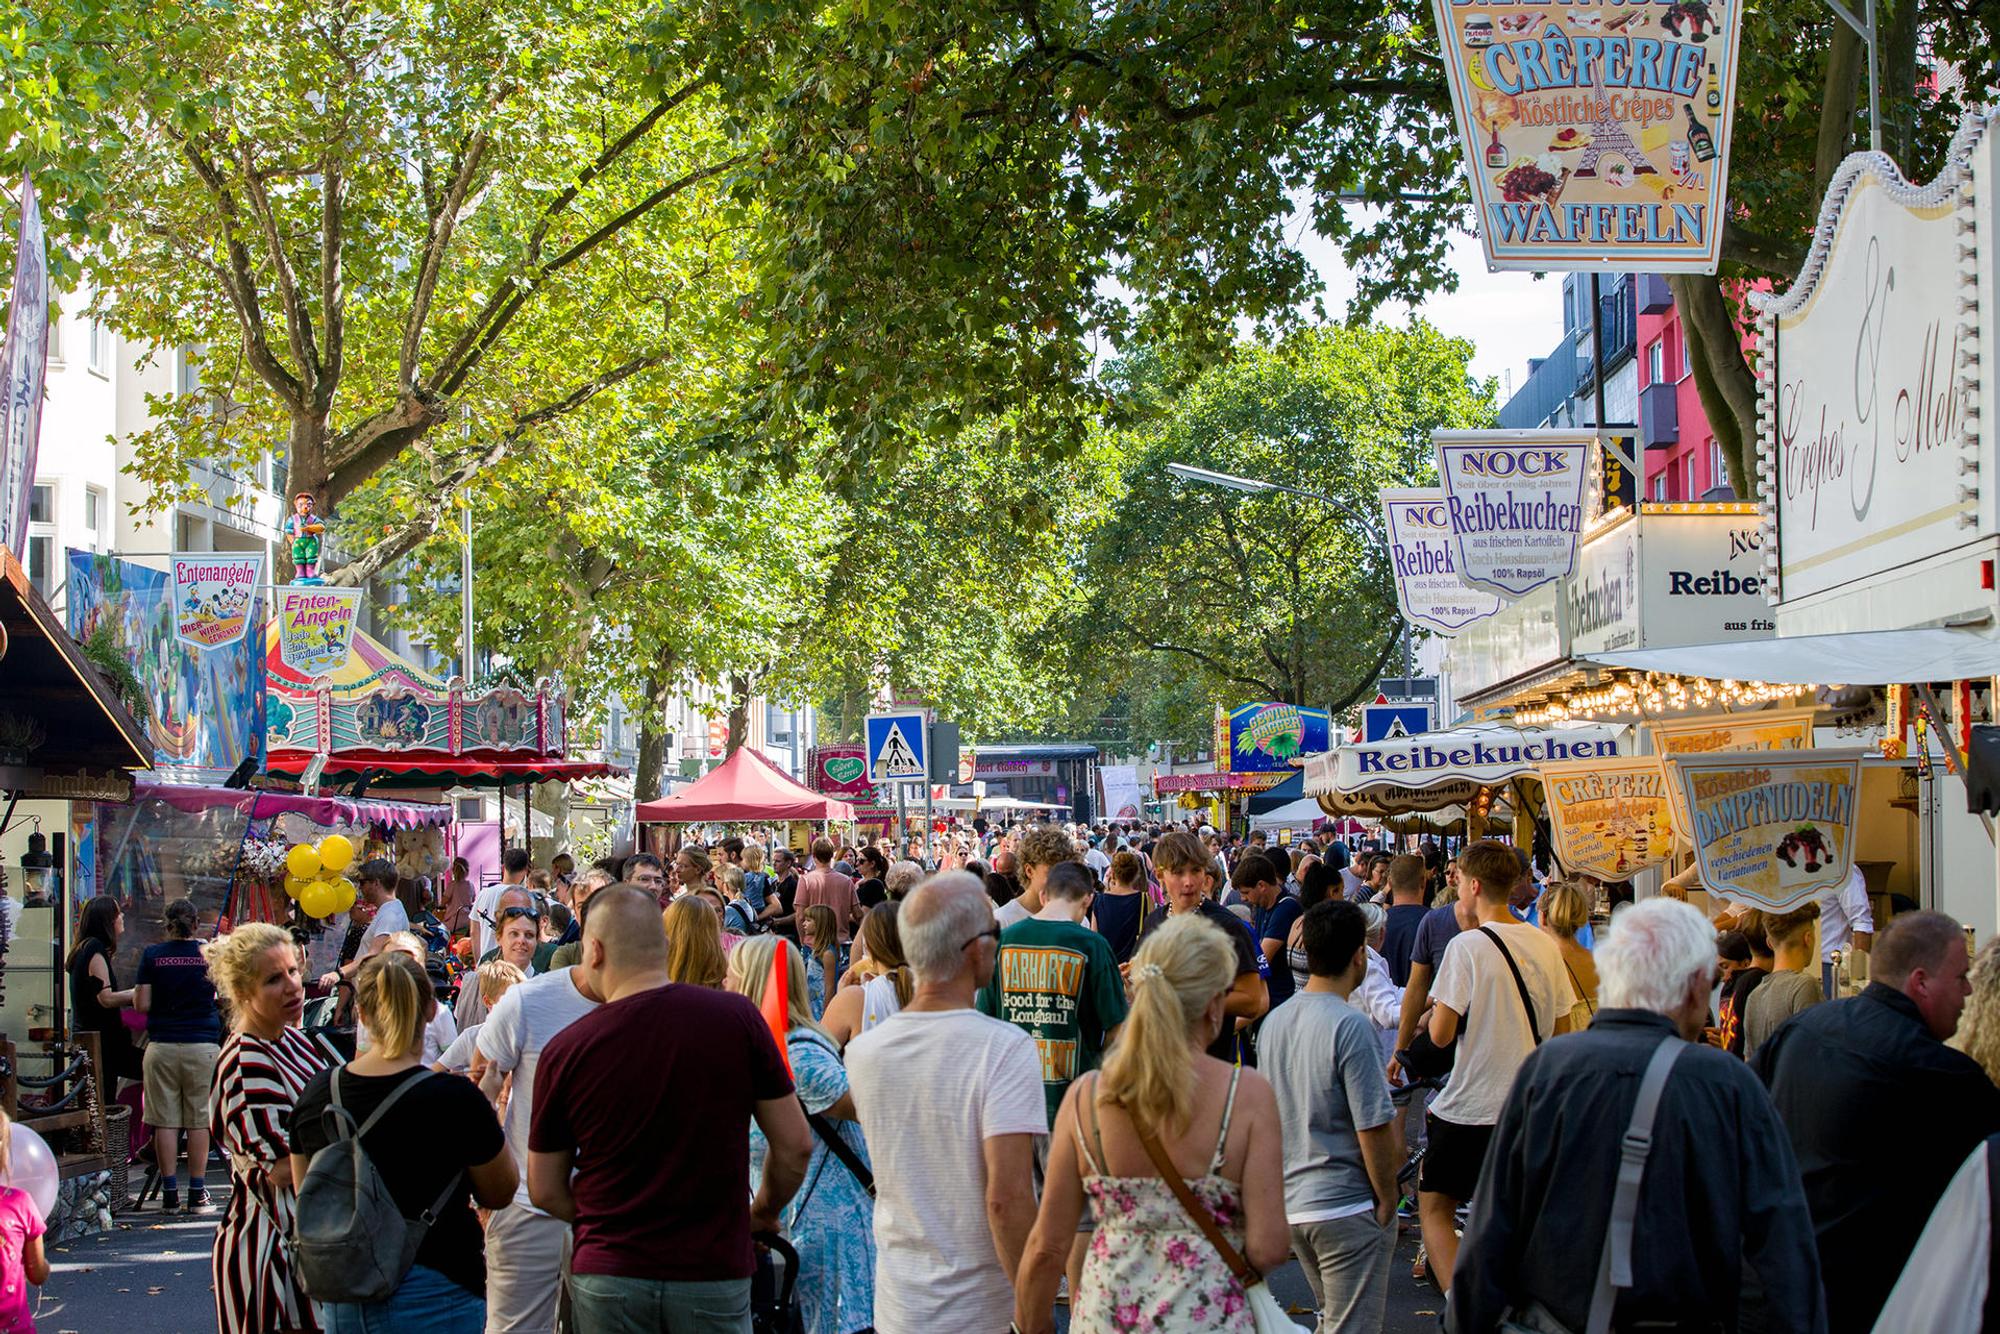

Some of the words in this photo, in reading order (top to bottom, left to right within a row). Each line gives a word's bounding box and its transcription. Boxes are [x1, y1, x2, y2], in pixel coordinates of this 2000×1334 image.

[1464, 29, 1493, 38] nutella
[1484, 22, 1708, 99] CRÊPERIE
[1518, 96, 1607, 127] Köstliche
[1609, 90, 1675, 129] Crêpes
[1488, 202, 1706, 244] WAFFELN
[1460, 450, 1571, 478] NOCK
[1477, 479, 1500, 489] über
[1538, 479, 1572, 488] Jahren
[1405, 506, 1448, 528] NO
[1447, 490, 1582, 536] Reibekuchen
[1472, 538, 1489, 548] aus
[1489, 535, 1523, 548] frischen
[1524, 535, 1566, 547] Kartoffeln
[1729, 529, 1765, 561] NO
[1393, 540, 1455, 578] Reibek
[1468, 553, 1492, 566] Nach
[176, 560, 255, 587] Entenangeln
[1414, 581, 1428, 589] aus
[1428, 579, 1457, 589] frischen
[1492, 569, 1515, 578] 100%
[1516, 568, 1545, 579] Rapsöl
[1669, 570, 1767, 596] Reibe
[284, 594, 342, 612] Enten-
[1430, 607, 1451, 615] 100%
[1452, 606, 1477, 616] Rapsöl
[1568, 571, 1622, 638] ibekuchen
[180, 620, 203, 636] HIER
[199, 623, 221, 638] WIRD
[291, 605, 353, 630] Angeln
[1724, 622, 1747, 631] aus
[1751, 620, 1776, 631] fris
[286, 640, 310, 653] Ente
[1358, 737, 1619, 774] Reibekuchen
[1161, 776, 1200, 789] GOLDEN
[1201, 776, 1227, 787] GATE
[1696, 767, 1772, 799] Köstliche
[1697, 780, 1854, 849] DAMPFNUDELN
[1710, 842, 1773, 869] verschiedenen
[1717, 859, 1769, 882] Variationen
[155, 957, 206, 967] TOCOTRON
[1003, 951, 1082, 995] CARHARTT
[1003, 993, 1034, 1008] Good
[1035, 993, 1053, 1008] for
[1055, 995, 1076, 1011] the
[1009, 1008, 1069, 1027] Longhaul
